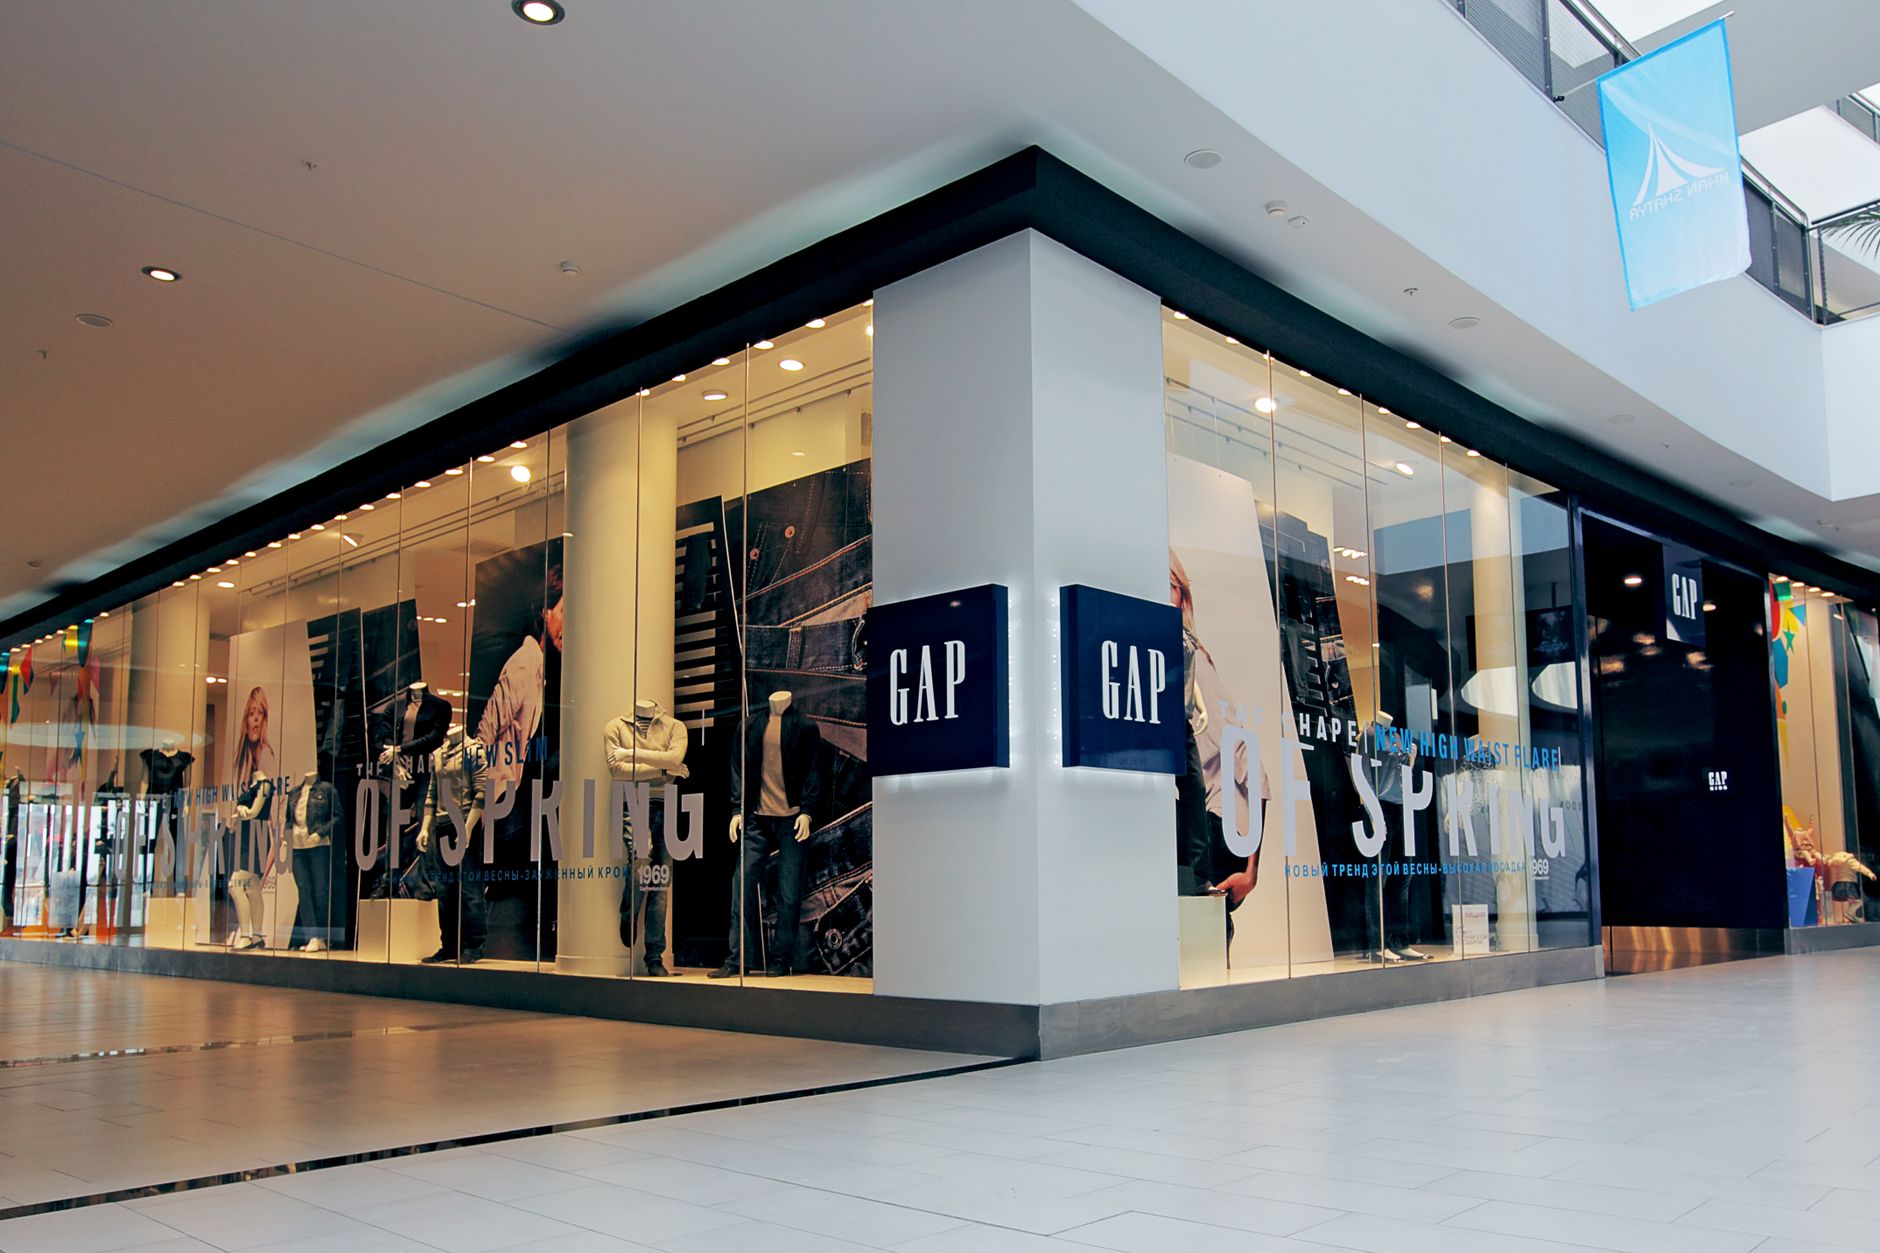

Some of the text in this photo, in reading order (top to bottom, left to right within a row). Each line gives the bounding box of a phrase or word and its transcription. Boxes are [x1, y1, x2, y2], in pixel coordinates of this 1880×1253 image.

[1671, 572, 1697, 620] GAP
[889, 640, 966, 726] GAP
[1101, 640, 1166, 724] GAP
[464, 744, 499, 770] NEW
[505, 735, 548, 766] SLIM
[1375, 724, 1413, 753] NEW
[1420, 731, 1459, 760] HIGH
[1464, 737, 1510, 766] WAIST
[1514, 745, 1558, 772] FLARE
[222, 780, 251, 801] WAIS
[1221, 724, 1566, 859] OF SPRING
[1708, 771, 1728, 786] GAP
[354, 777, 704, 871] OF SPRING
[637, 864, 670, 885] 1969
[1285, 862, 1329, 878] НОВЫЙ
[1332, 863, 1369, 878] ТРЕНД
[1372, 861, 1400, 876] ЭТОЙ
[1530, 859, 1549, 875] 969
